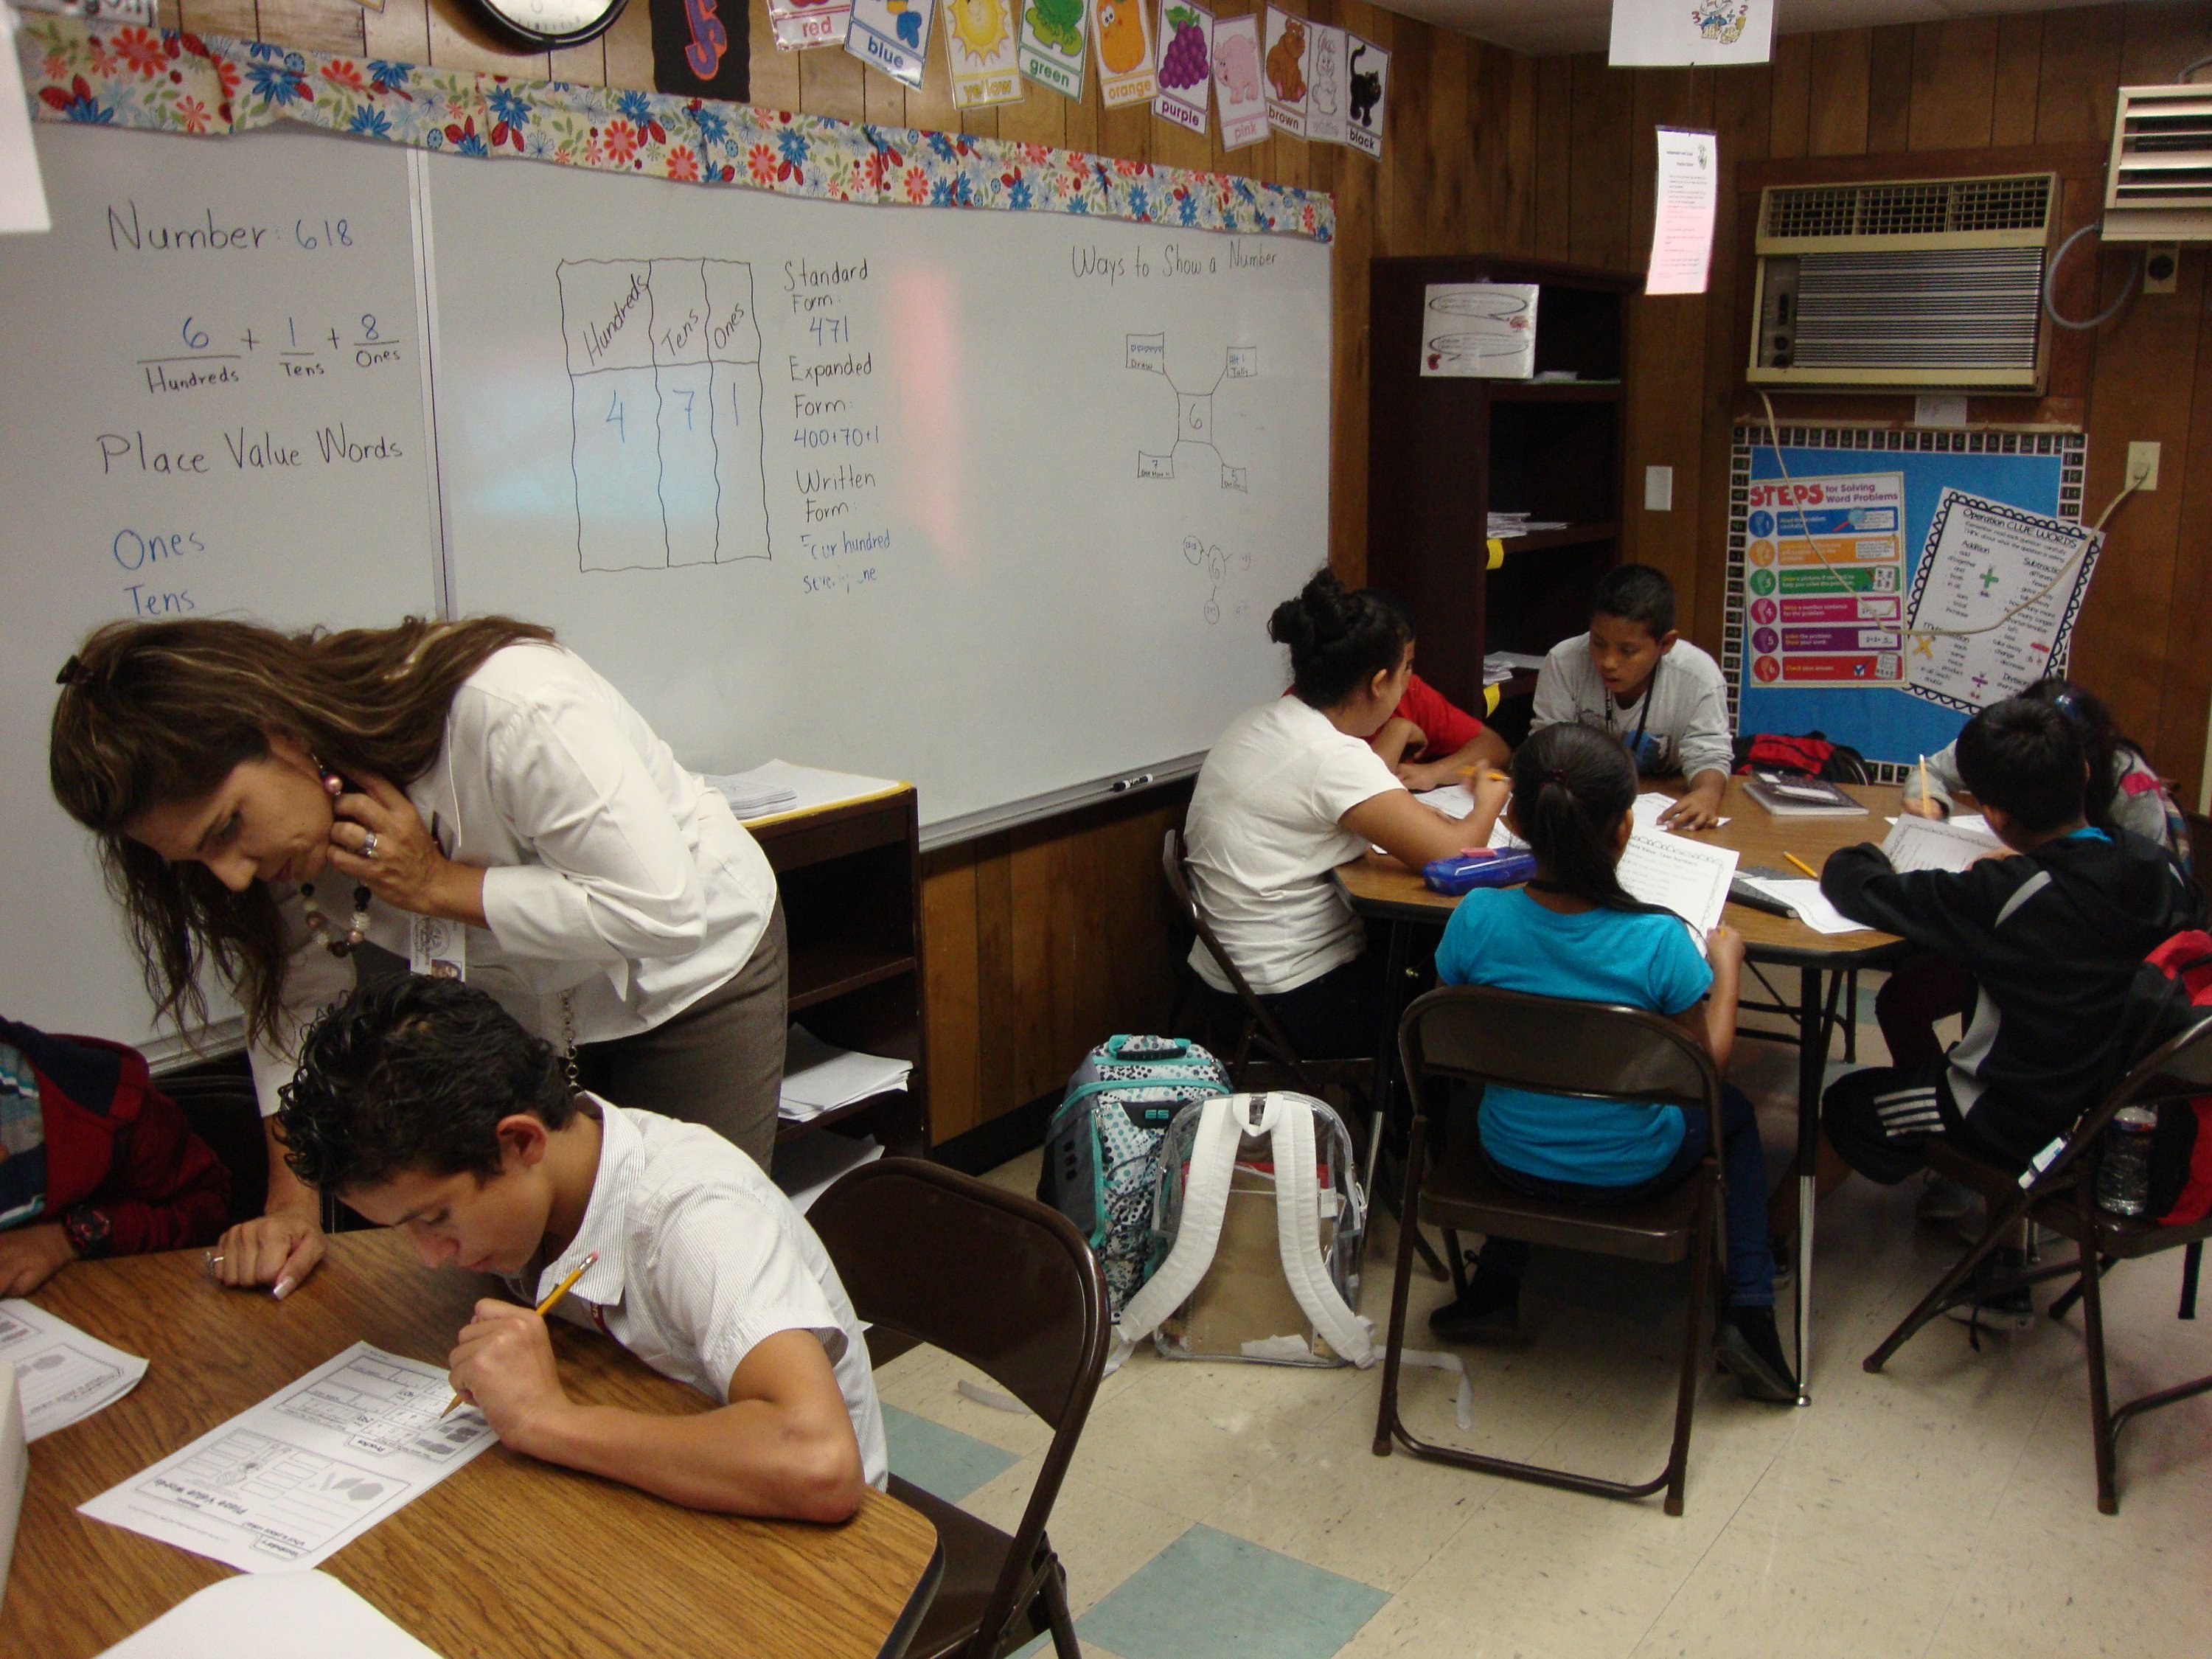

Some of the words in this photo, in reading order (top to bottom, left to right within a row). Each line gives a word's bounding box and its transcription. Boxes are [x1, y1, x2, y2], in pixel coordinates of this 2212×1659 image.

[802, 16, 832, 38] red
[868, 36, 904, 69] blue
[1029, 57, 1071, 88] green
[963, 78, 1012, 103] yellow
[1108, 80, 1153, 100] orange
[1162, 100, 1200, 126] purple
[1269, 105, 1298, 129] brown
[1234, 122, 1257, 142] pink
[1349, 128, 1374, 149] black
[296, 220, 353, 249] 618
[785, 258, 868, 291] Standard
[1072, 245, 1125, 286] Ways
[1135, 246, 1150, 277] to
[1164, 243, 1201, 277] Show
[1209, 256, 1217, 274] a
[1229, 240, 1278, 270] Number
[184, 317, 209, 349] 6
[289, 318, 296, 347] 1
[361, 314, 379, 340] 8
[583, 274, 649, 366] Hundreds
[661, 309, 698, 355] Tens
[714, 302, 744, 349] Ones
[809, 316, 849, 347] 471
[146, 366, 240, 394] Hundreds
[279, 362, 324, 378] Tens
[355, 349, 400, 367] Ones
[790, 353, 872, 386] Expanded
[1131, 359, 1152, 369] Draw
[606, 390, 625, 442] 4
[673, 390, 695, 430] 7
[732, 382, 739, 426] 1
[1189, 403, 1203, 430] 6
[97, 431, 210, 474] Place
[224, 428, 302, 470] Value
[316, 422, 403, 463] Words
[797, 470, 876, 494] Written
[1750, 484, 1824, 507] STEPS
[1826, 485, 1838, 493] for
[1841, 484, 1876, 493] Solving
[1826, 494, 1851, 503] Word
[1854, 493, 1898, 501] Problems
[843, 528, 890, 554] hundred
[1964, 509, 2005, 527] Operation
[2007, 521, 2033, 535] CLUE
[2037, 529, 2077, 549] WORDS
[114, 529, 205, 570] Ones
[124, 585, 195, 616] Tens
